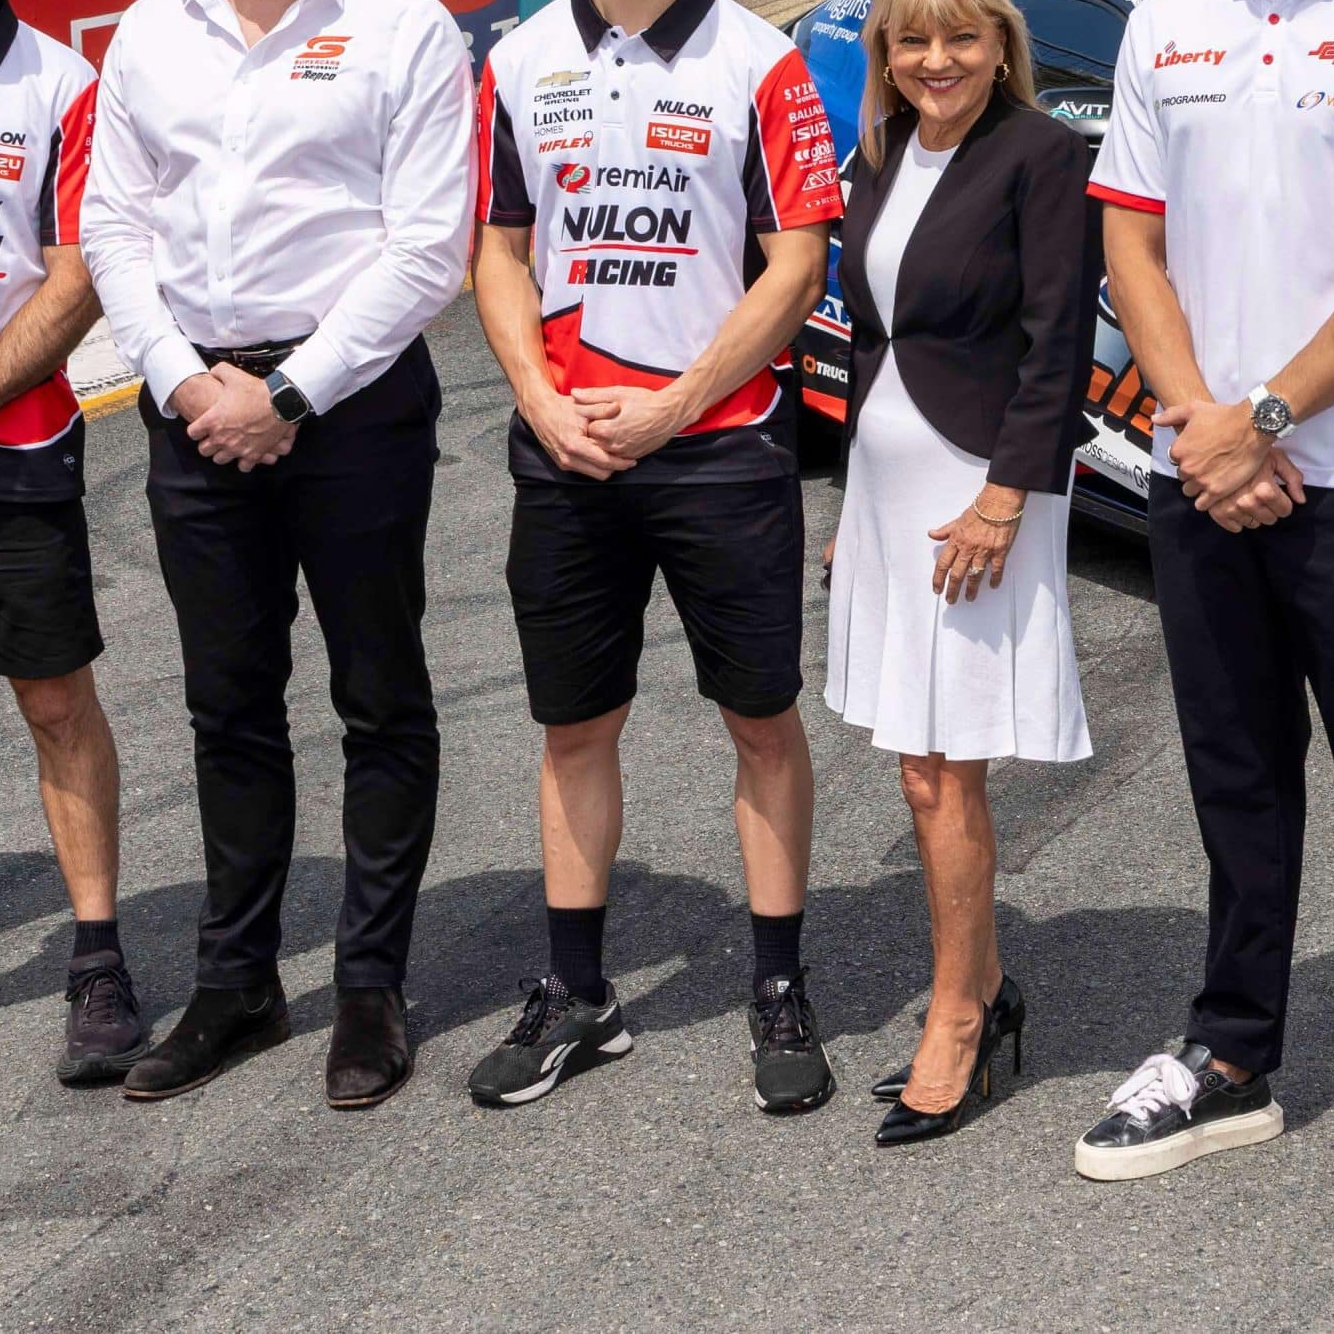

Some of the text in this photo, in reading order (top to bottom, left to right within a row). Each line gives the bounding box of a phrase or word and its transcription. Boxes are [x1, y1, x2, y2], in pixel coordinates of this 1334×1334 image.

[1154, 42, 1228, 69] Liberty
[533, 88, 593, 104] CHEVROLET
[544, 97, 580, 107] RACING
[1161, 92, 1227, 108] PROGRAMMED
[533, 106, 594, 128] Luxton
[652, 98, 715, 120] NULON
[534, 125, 565, 137] HOMES
[650, 125, 707, 144] ISUZU
[538, 132, 594, 154] HIFLEX
[659, 138, 695, 151] TRUCKS
[596, 164, 691, 193] remiAir
